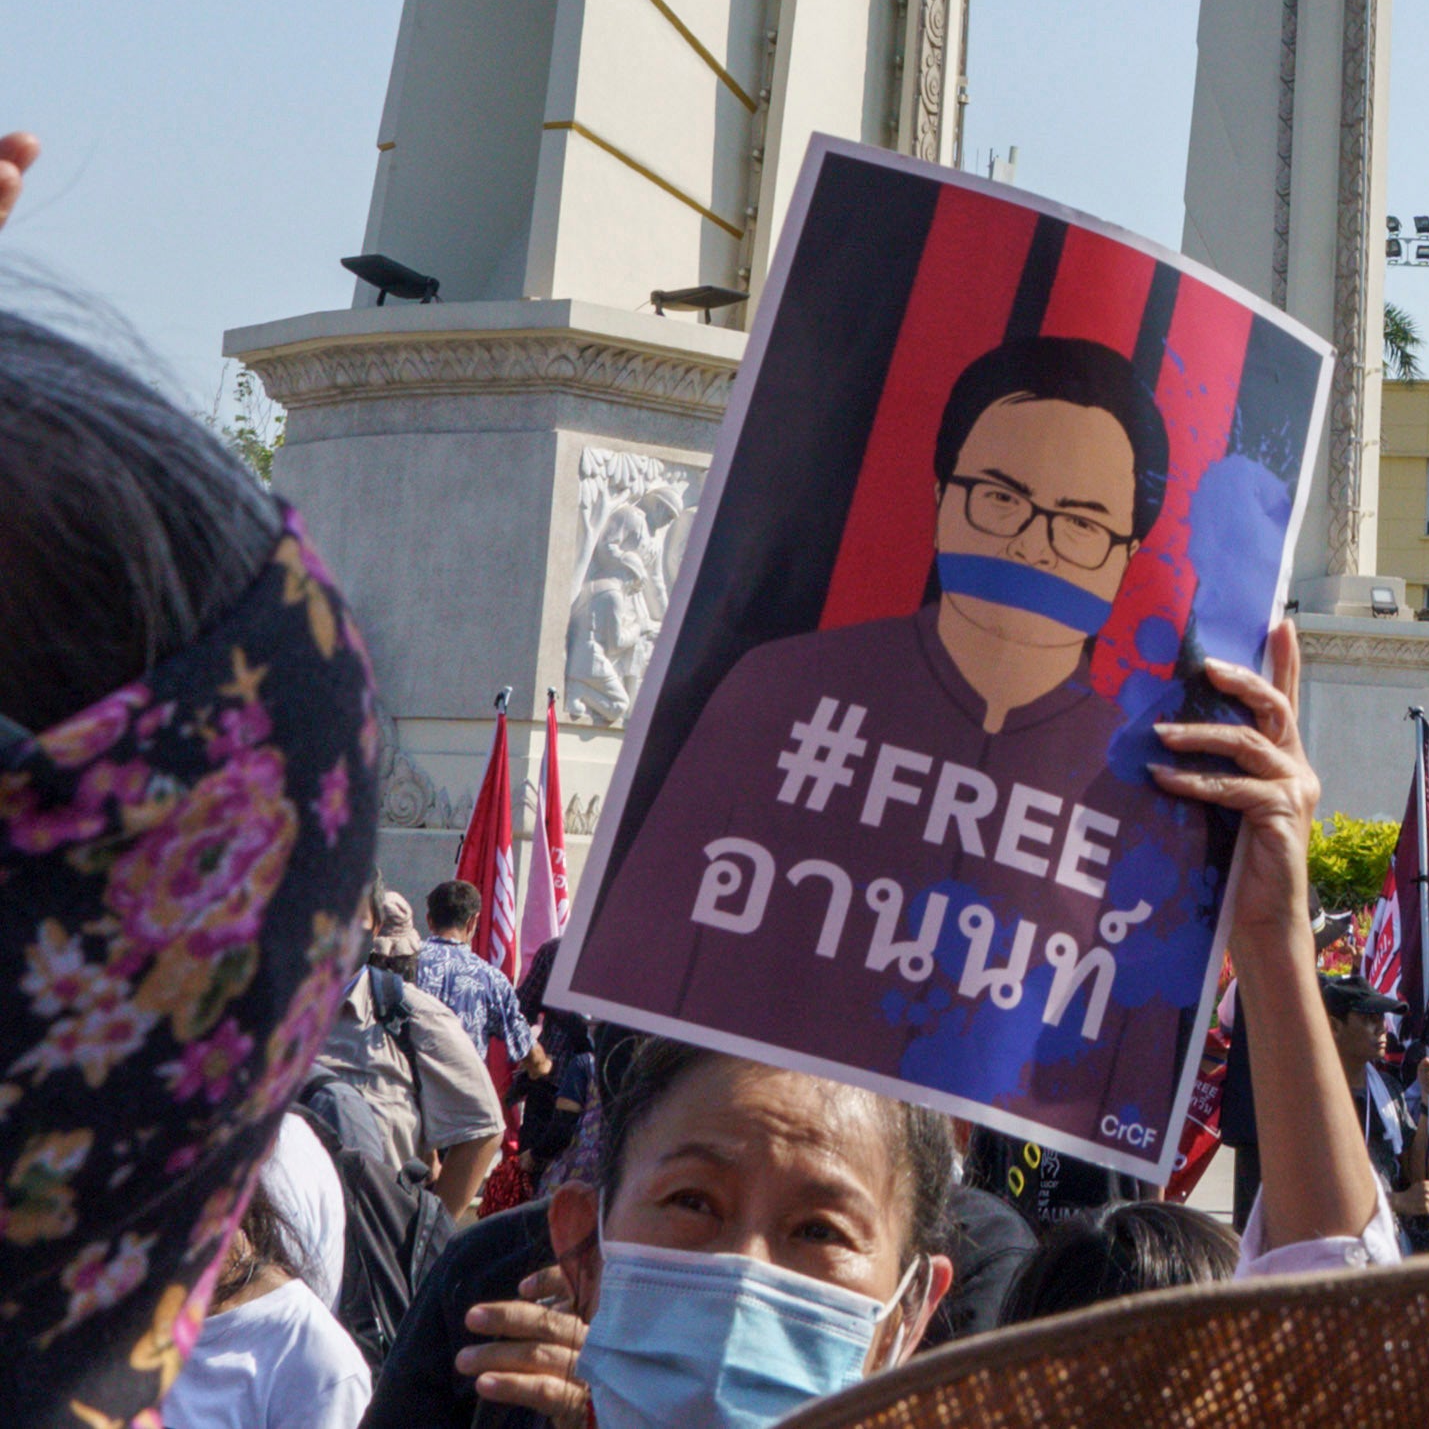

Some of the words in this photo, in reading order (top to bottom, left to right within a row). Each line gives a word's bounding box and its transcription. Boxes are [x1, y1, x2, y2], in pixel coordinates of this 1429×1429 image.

[775, 696, 1122, 899] #FREE
[690, 836, 1154, 1042] อานนท์
[1101, 1114, 1157, 1149] CrCF
